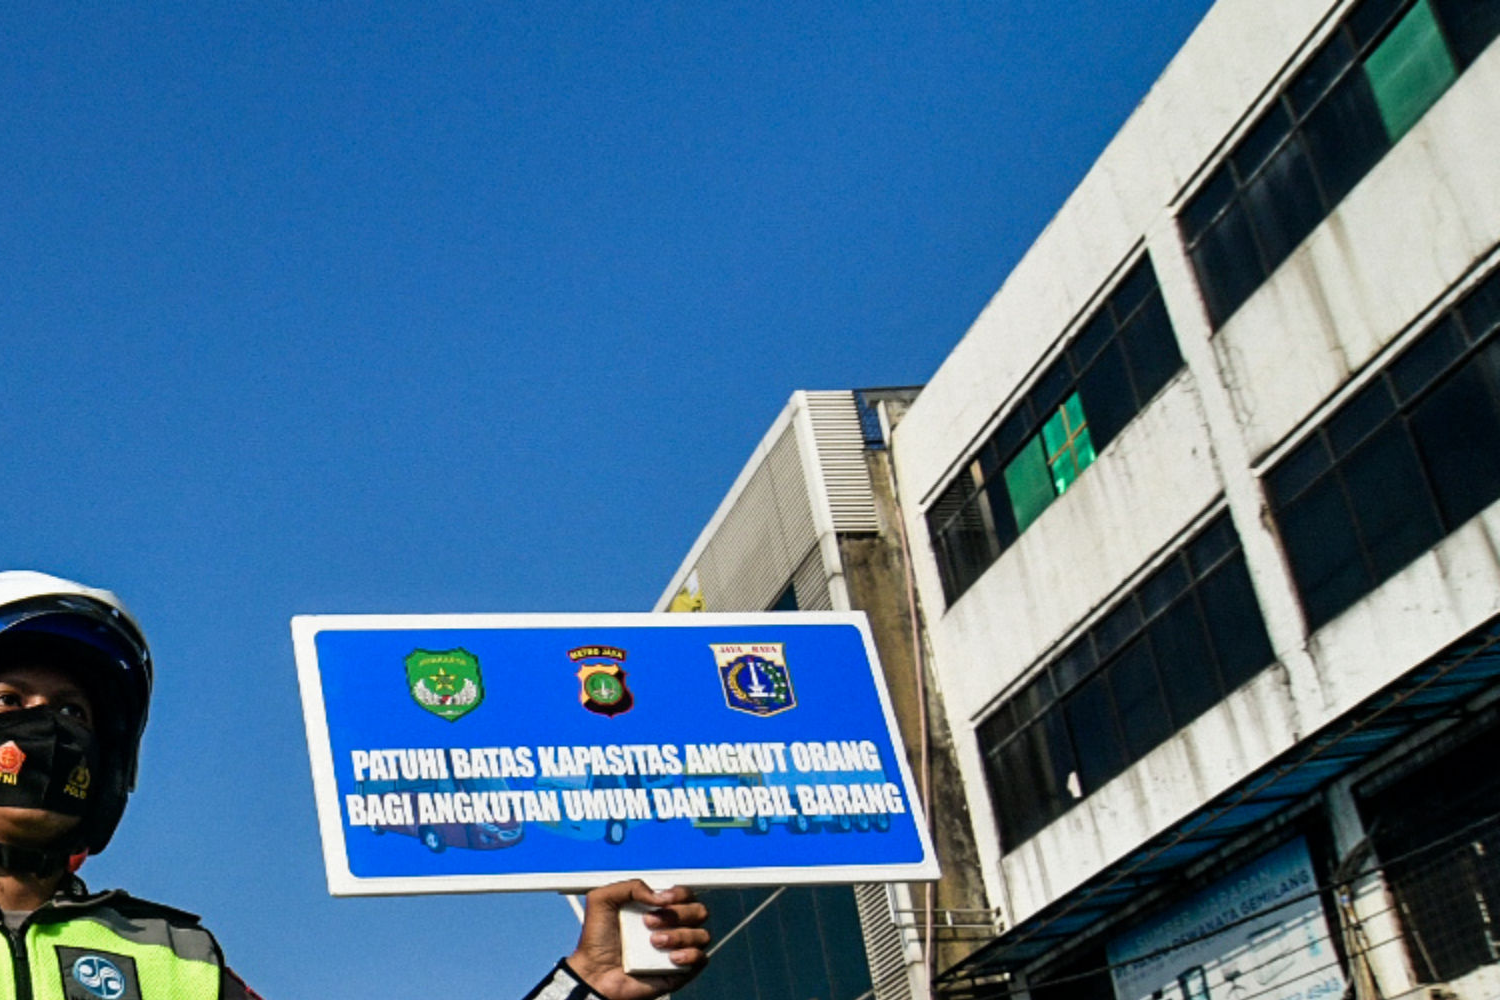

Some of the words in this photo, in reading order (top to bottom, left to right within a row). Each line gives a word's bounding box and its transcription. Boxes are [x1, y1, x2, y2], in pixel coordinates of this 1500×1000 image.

[351, 749, 449, 781] PATUHI
[450, 747, 536, 779] BATAS
[537, 744, 683, 778] KAPASITAS
[684, 742, 789, 774] ANGKUT
[790, 740, 883, 772] ORANG
[345, 792, 414, 826] BAGI
[417, 789, 562, 825] ANGKUTAN
[561, 787, 652, 821] UMUM
[652, 786, 711, 819] DAN
[709, 784, 799, 818] MOBIL
[796, 782, 906, 815] BARANG
